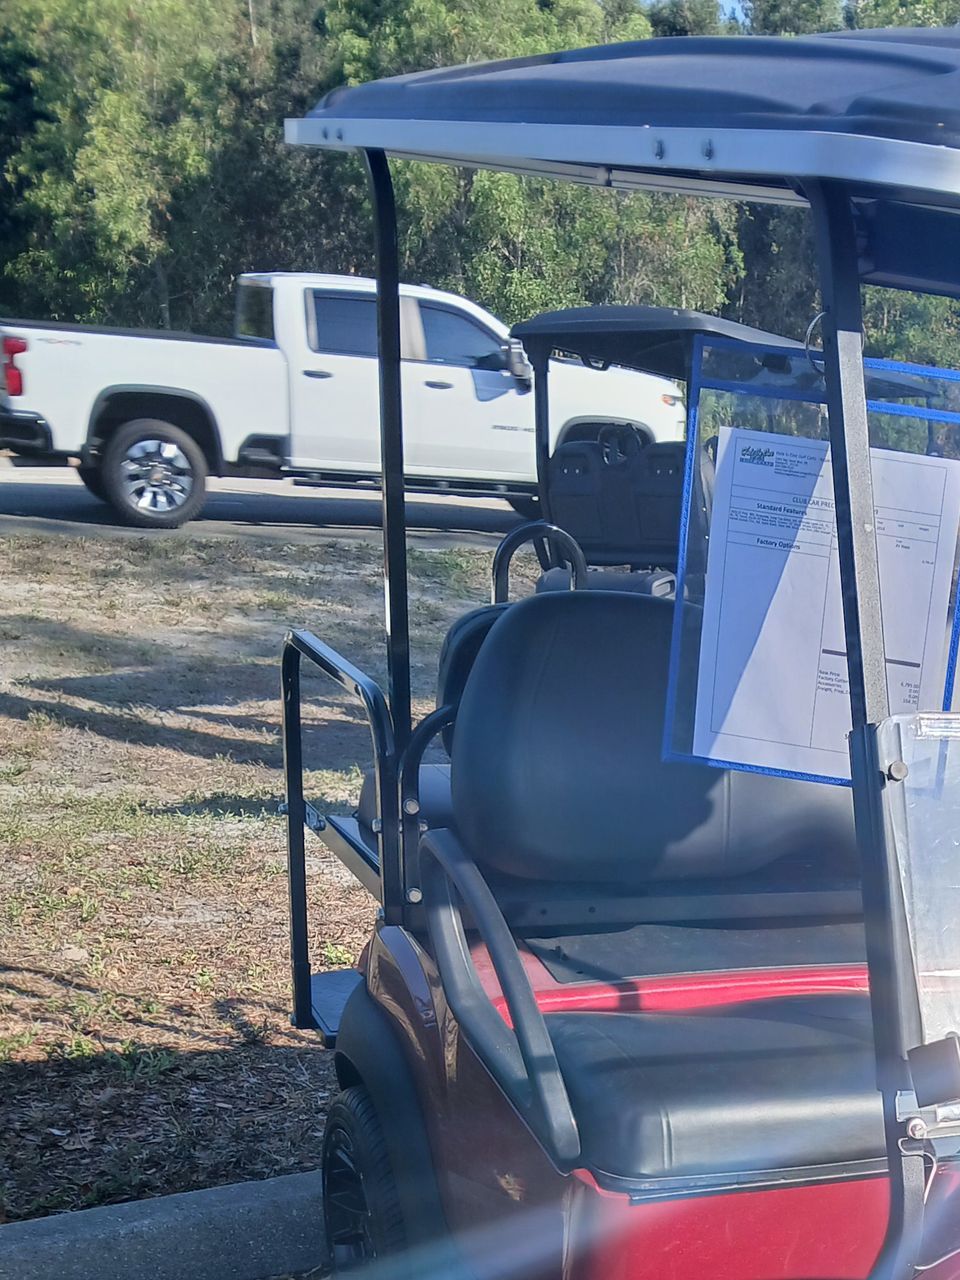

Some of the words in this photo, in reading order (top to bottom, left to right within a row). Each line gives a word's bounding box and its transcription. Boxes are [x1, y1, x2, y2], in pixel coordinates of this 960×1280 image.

[792, 496, 807, 505] CLUB
[808, 499, 819, 507] CAR
[820, 500, 835, 509] PREC
[756, 503, 782, 513] Standard
[783, 506, 807, 516] Features
[756, 537, 777, 548] Factory
[779, 541, 801, 550] Options
